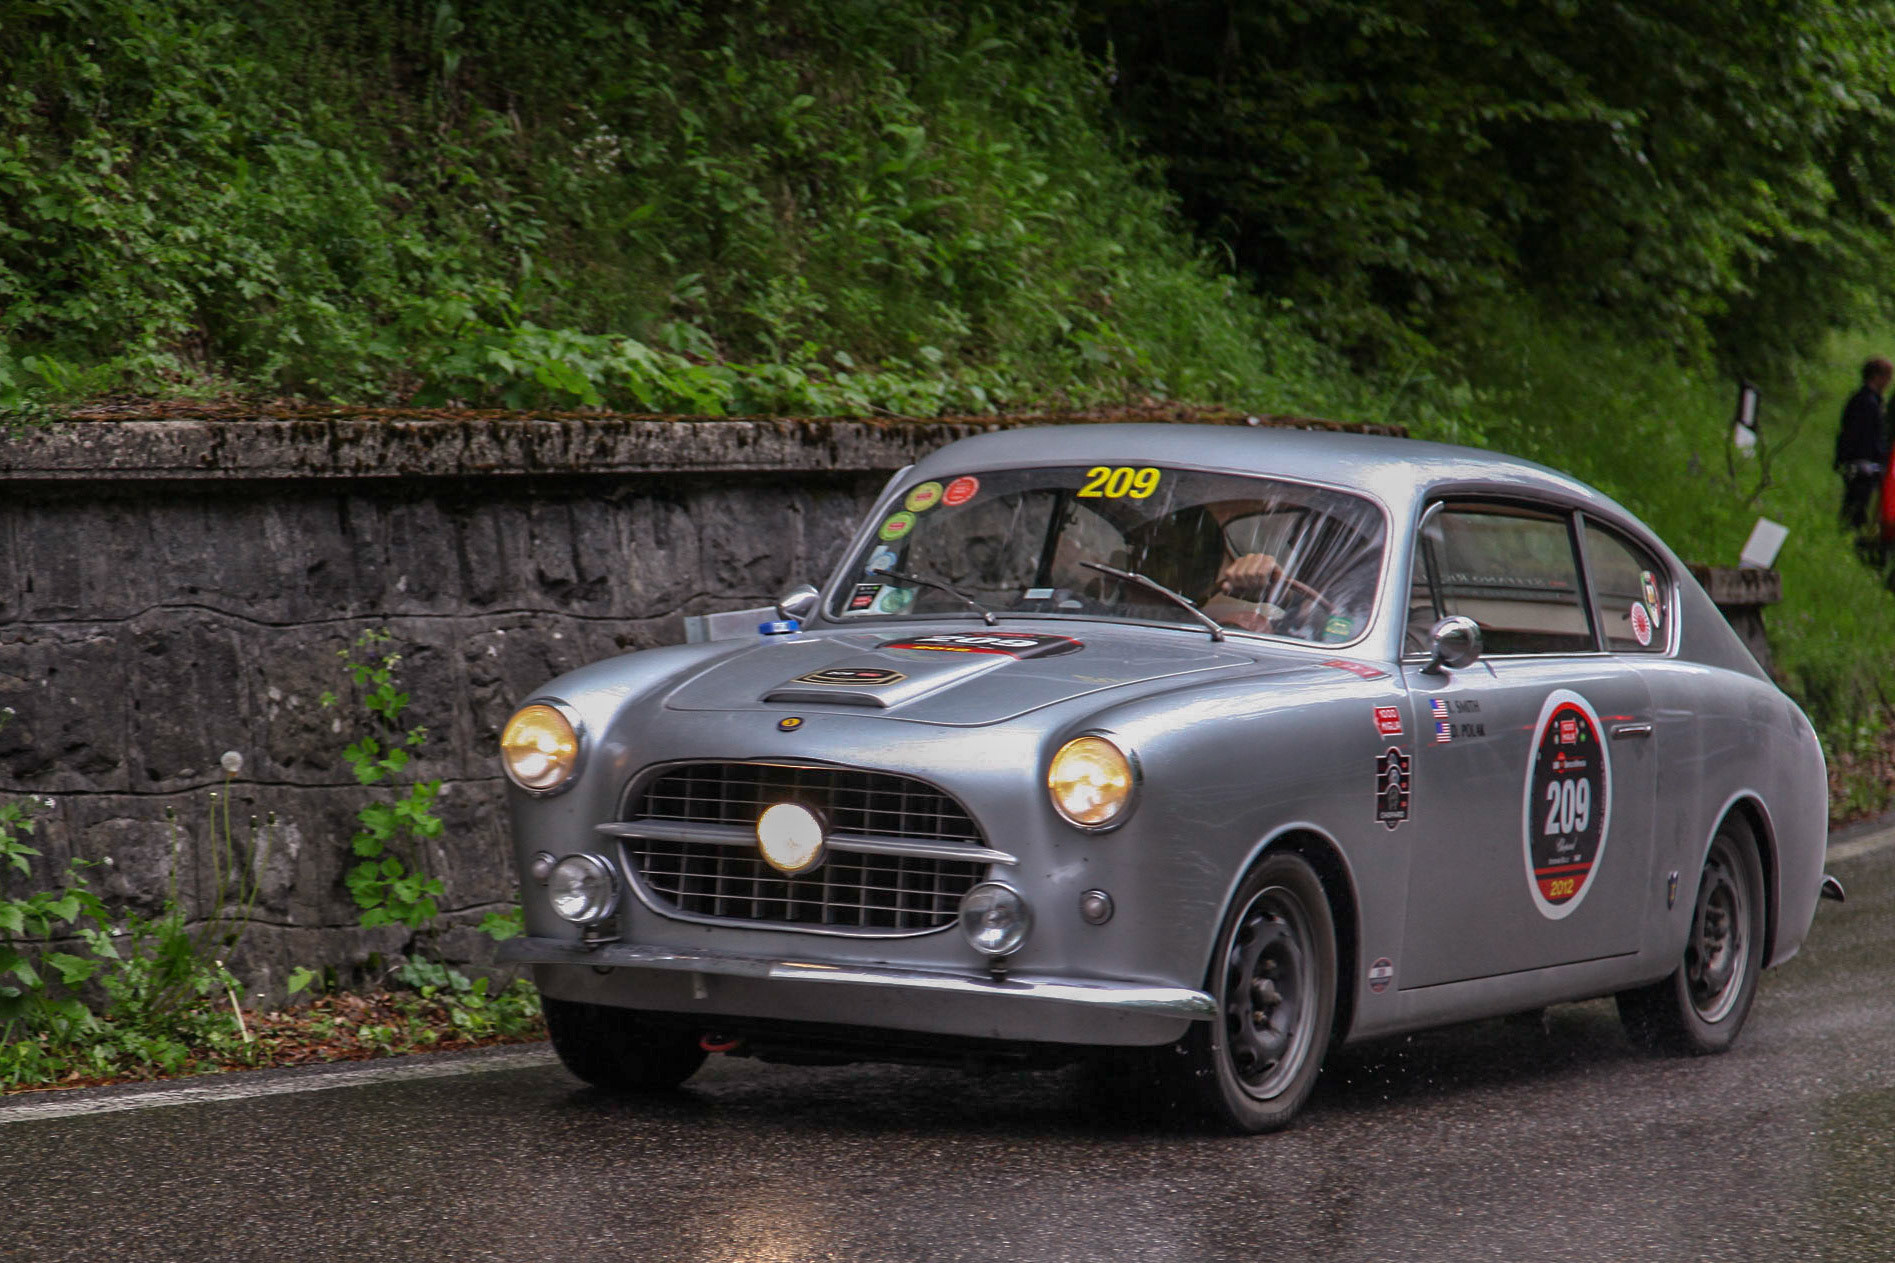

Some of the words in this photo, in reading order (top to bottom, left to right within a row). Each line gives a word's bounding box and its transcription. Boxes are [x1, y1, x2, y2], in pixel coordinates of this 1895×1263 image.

[1077, 466, 1161, 499] 209
[915, 635, 1039, 648] 209
[1378, 709, 1397, 719] 1000
[1455, 699, 1481, 714] SMITH
[1544, 777, 1592, 835] 209
[1549, 878, 1574, 897] 2012
